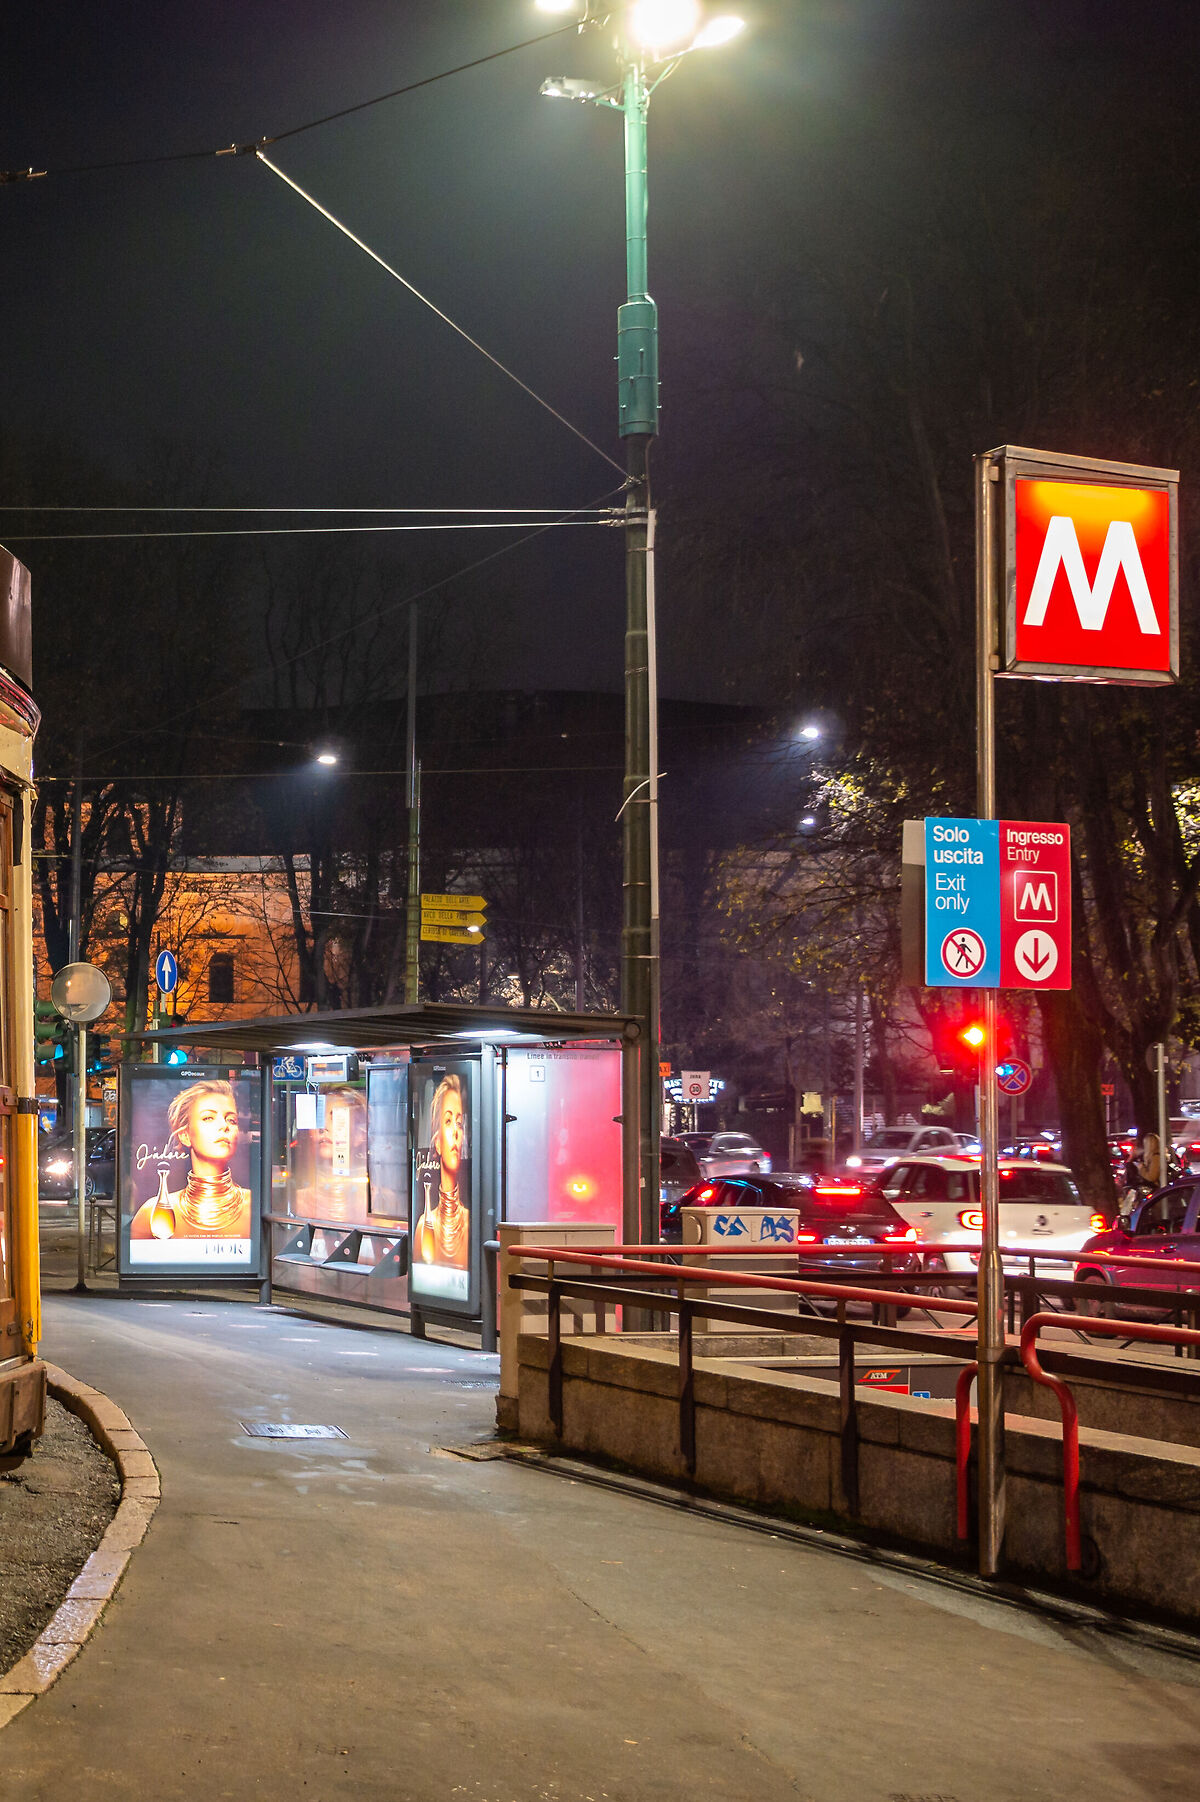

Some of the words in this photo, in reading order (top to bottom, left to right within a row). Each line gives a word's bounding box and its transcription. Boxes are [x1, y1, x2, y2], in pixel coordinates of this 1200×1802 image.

[1022, 515, 1161, 635] M
[933, 825, 970, 843] Solo
[1006, 829, 1064, 846] Ingresso
[933, 848, 984, 865] uscita
[1007, 846, 1040, 865] Entry
[935, 872, 966, 891] Exit
[935, 893, 970, 914] only
[1019, 882, 1053, 911] M
